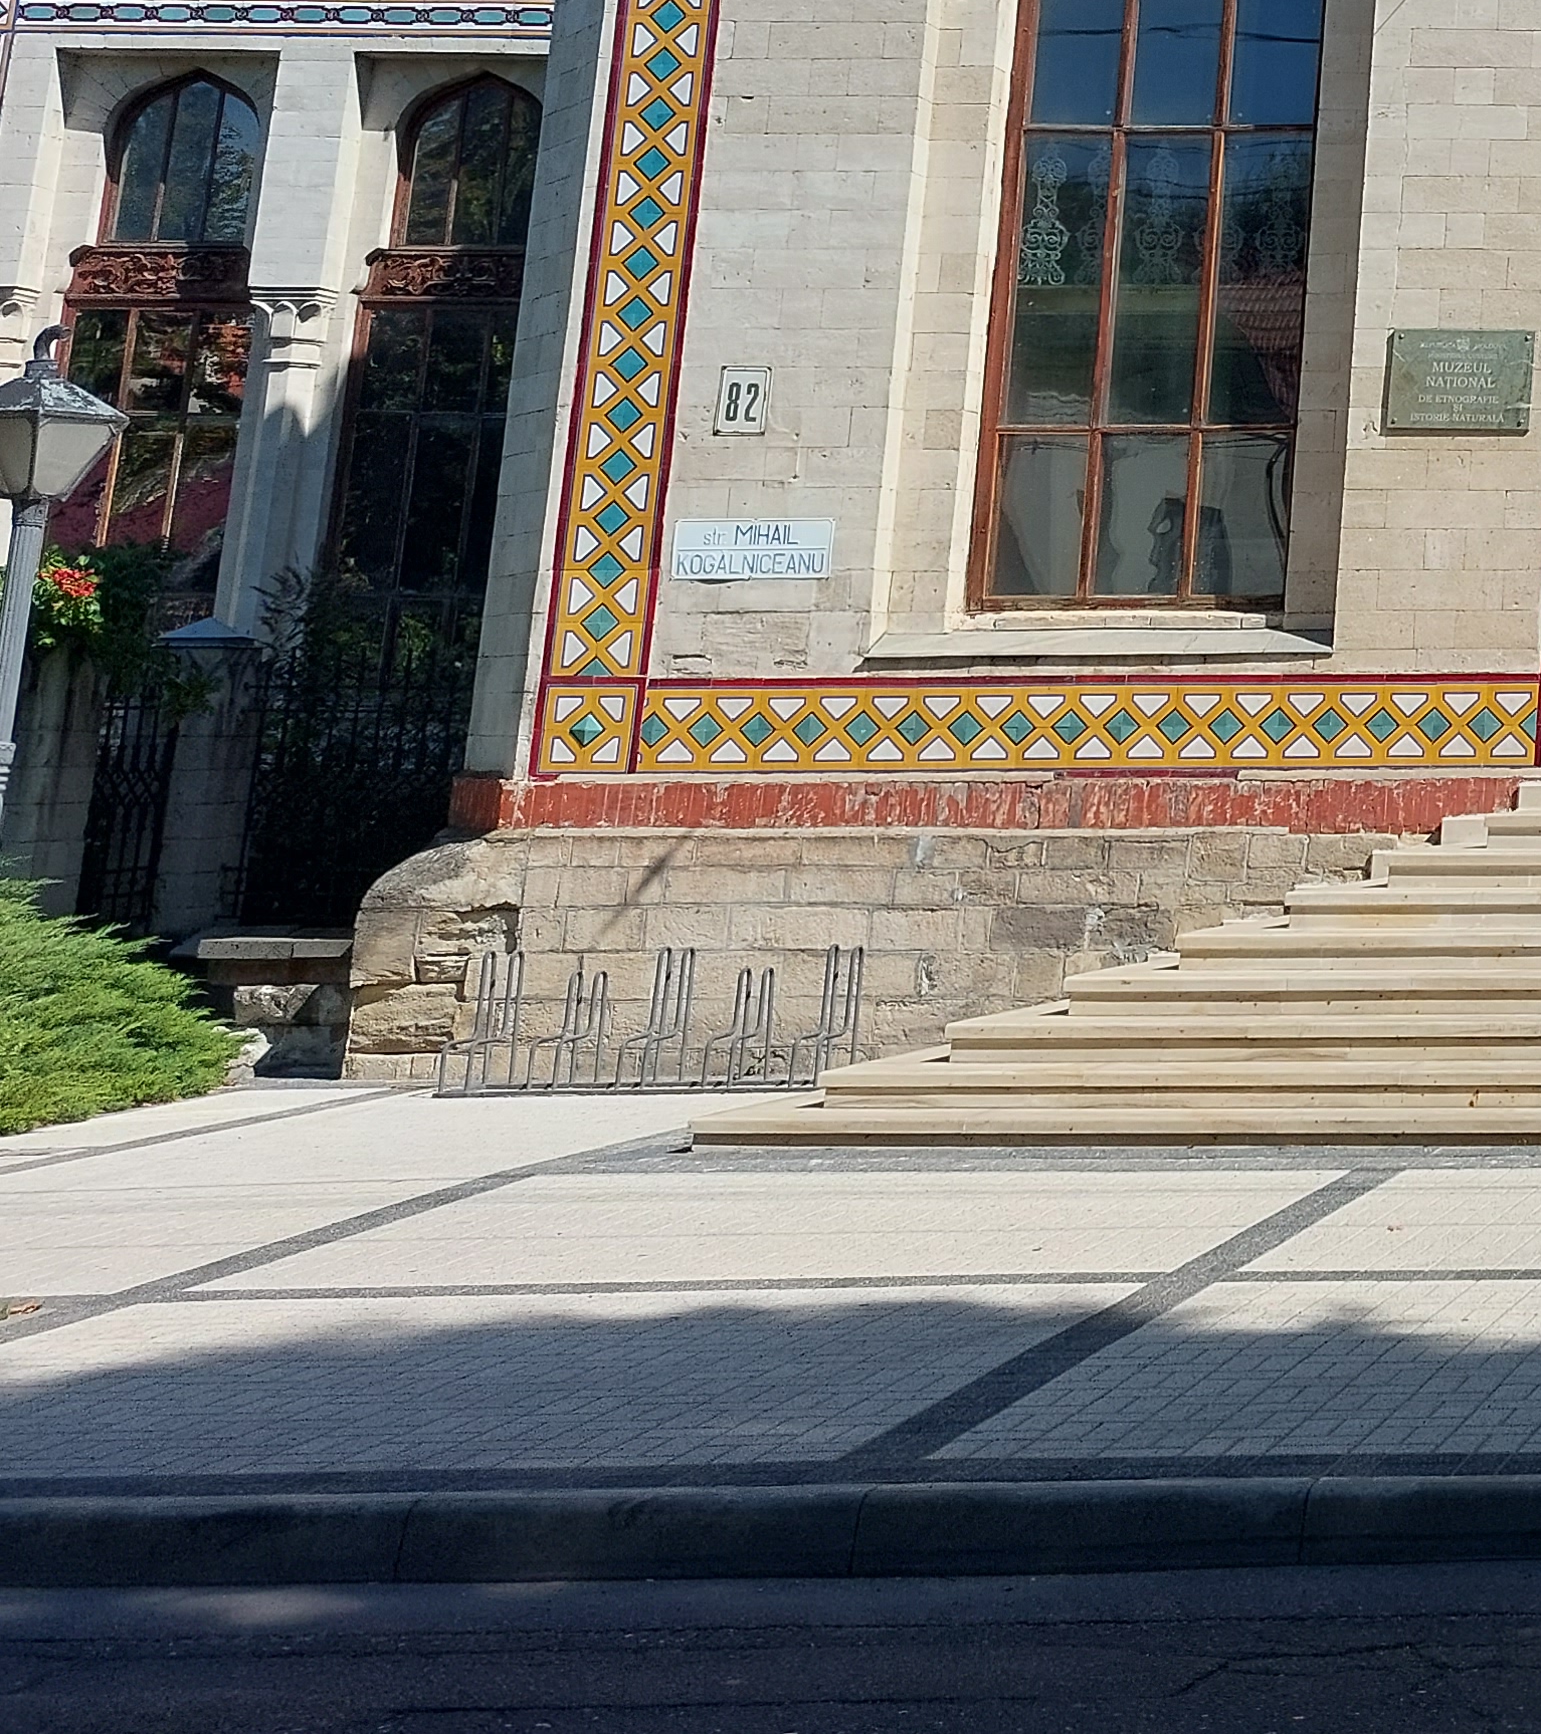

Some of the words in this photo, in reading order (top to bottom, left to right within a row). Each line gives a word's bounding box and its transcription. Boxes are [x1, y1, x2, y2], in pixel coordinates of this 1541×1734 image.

[1431, 361, 1492, 374] MUZEUL
[724, 382, 760, 422] 82
[1418, 394, 1433, 403] DE
[1435, 394, 1500, 404] ETNOGRAFIE
[1410, 412, 1450, 422] ISTORIE
[734, 523, 799, 546] MIHAIL
